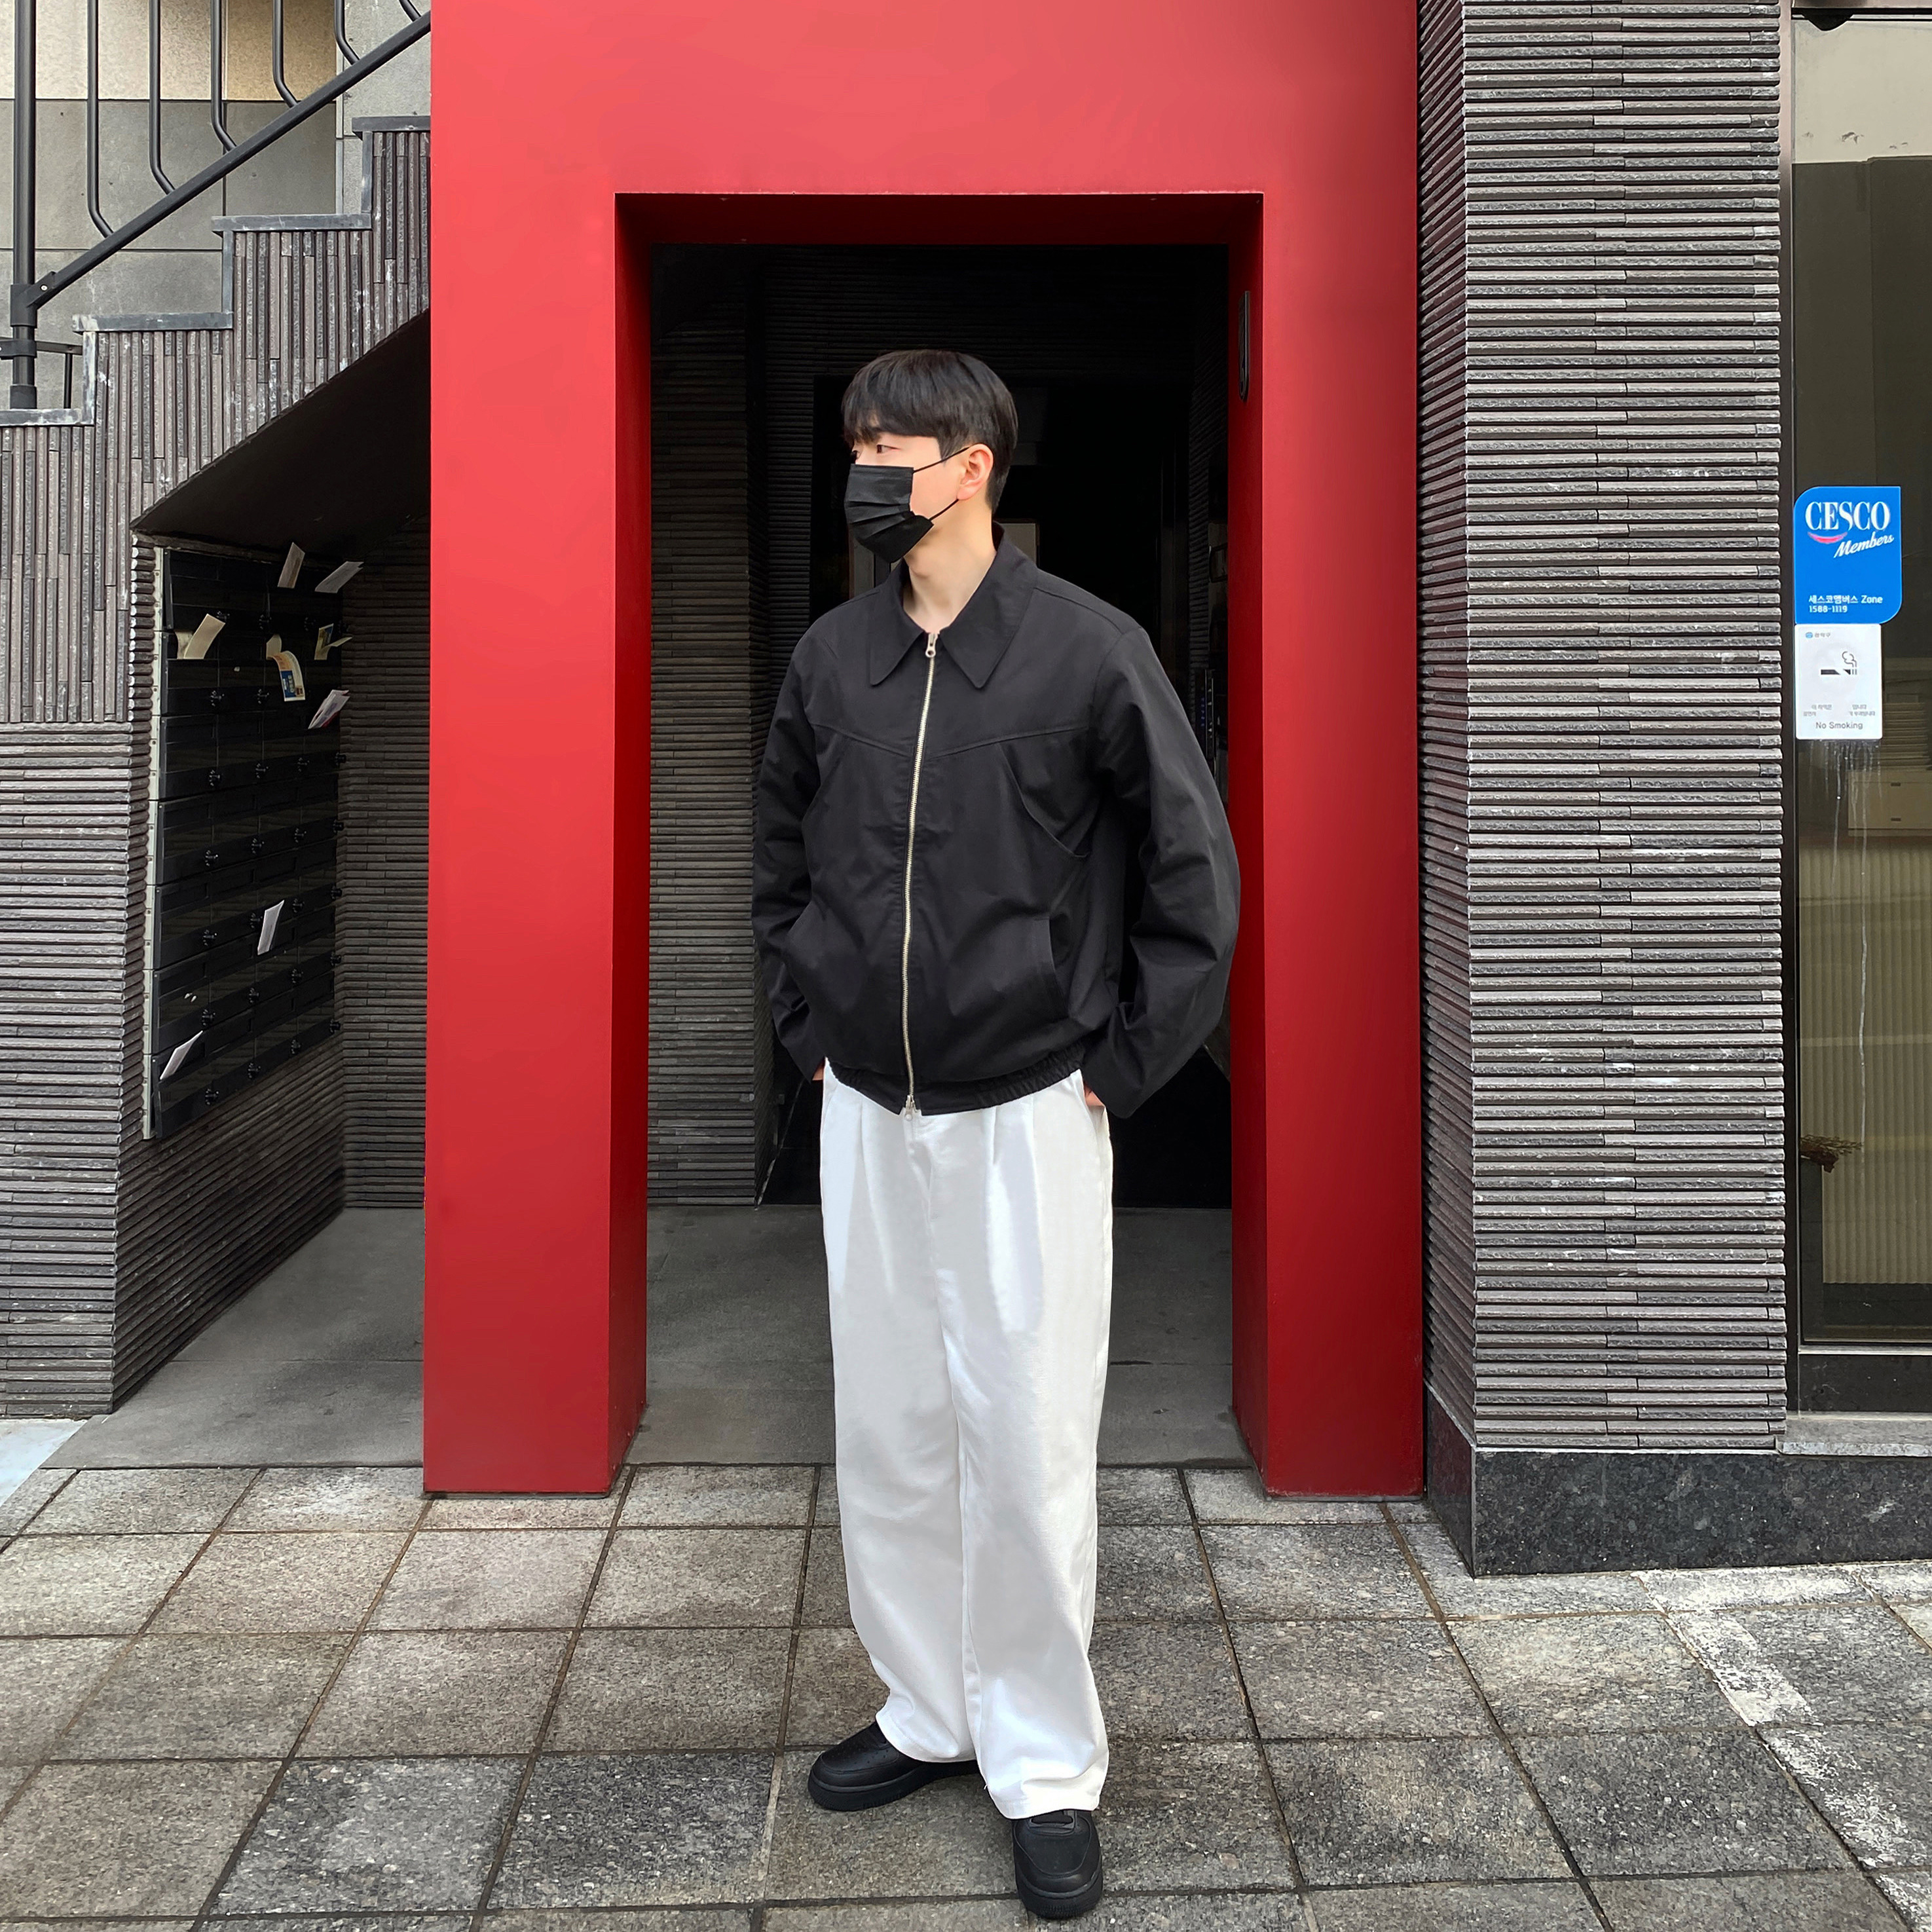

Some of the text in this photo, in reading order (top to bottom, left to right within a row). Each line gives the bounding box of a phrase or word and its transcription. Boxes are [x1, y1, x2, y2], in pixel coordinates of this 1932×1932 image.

[1805, 501, 1891, 531] CESCO
[1833, 531, 1895, 559] Members
[1861, 595, 1884, 604] Zone
[1829, 722, 1864, 730] Smoking
